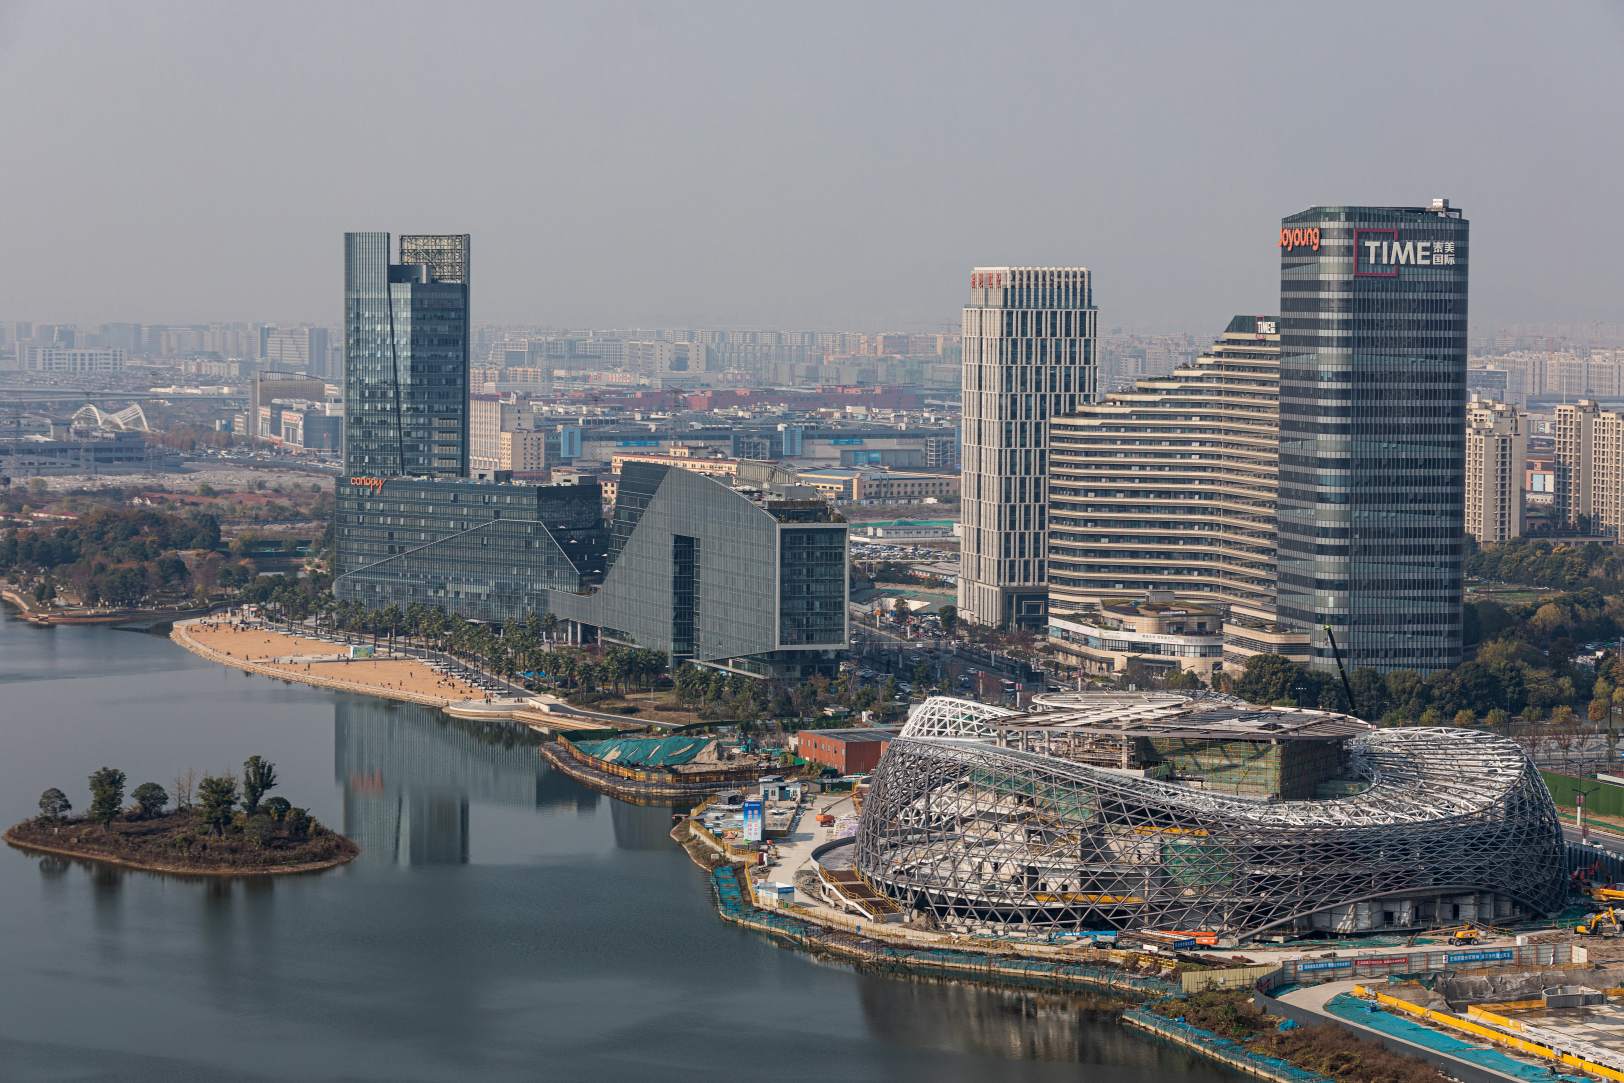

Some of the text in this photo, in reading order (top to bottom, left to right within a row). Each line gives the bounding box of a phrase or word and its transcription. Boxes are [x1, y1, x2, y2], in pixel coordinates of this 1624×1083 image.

[1364, 241, 1431, 265] TIME
[1432, 254, 1456, 266] 国际
[351, 477, 387, 495] canopy
